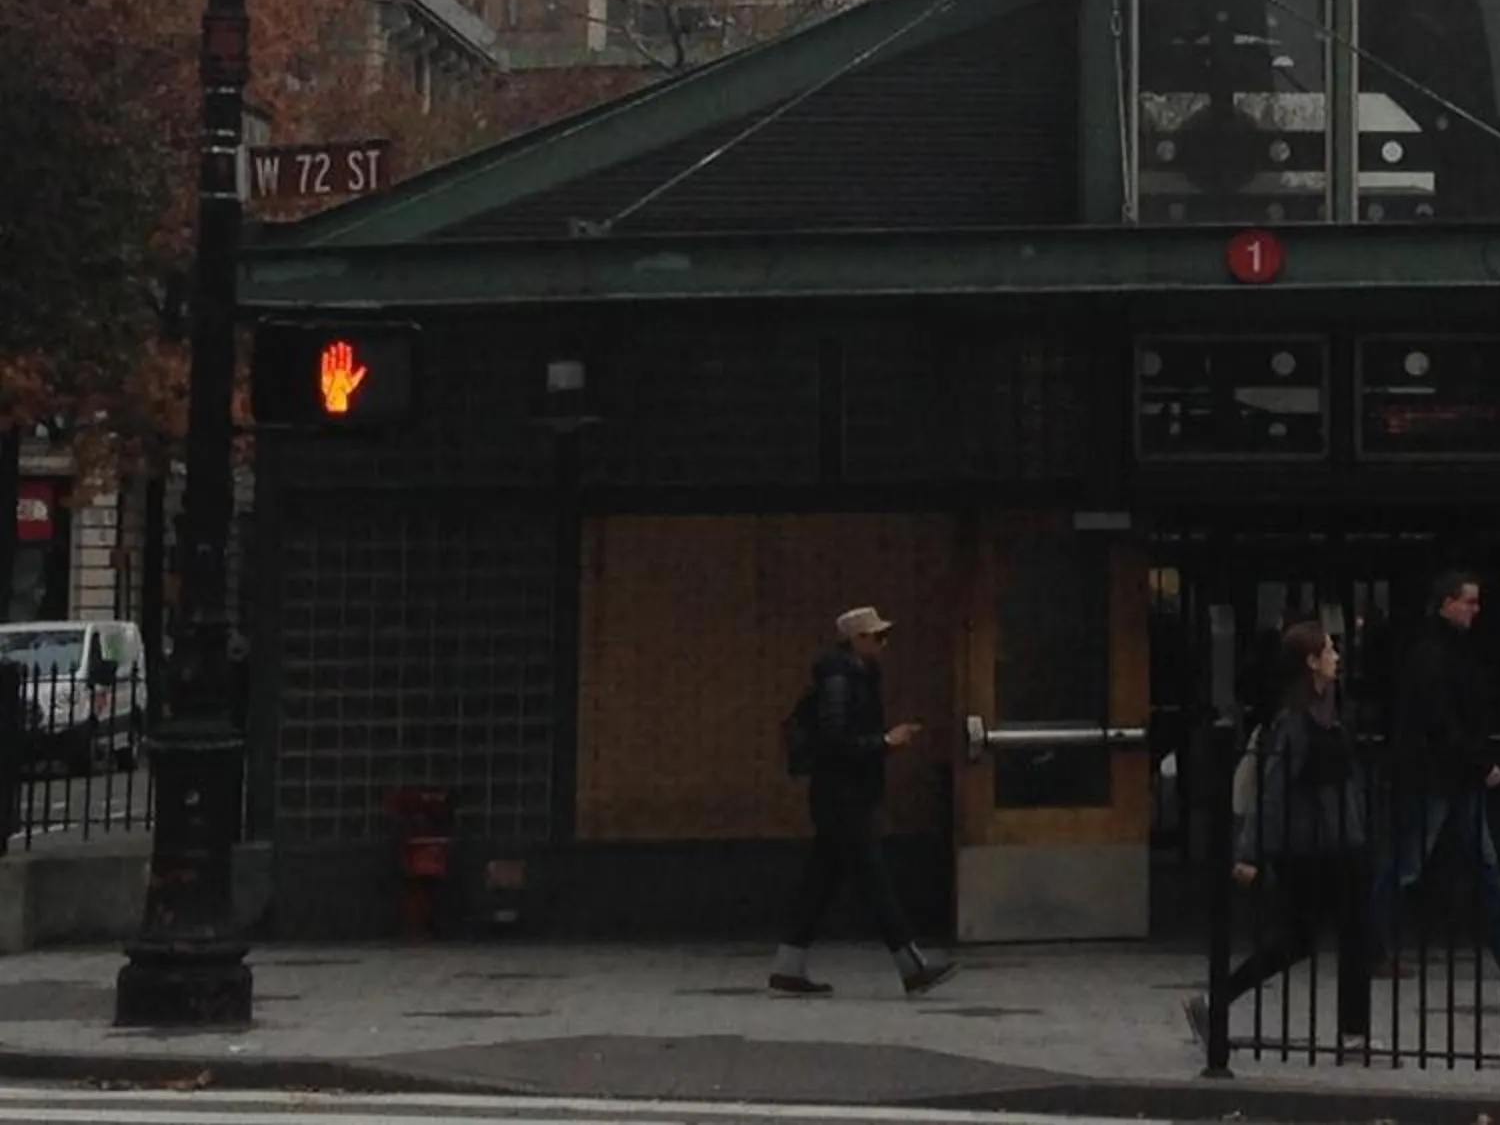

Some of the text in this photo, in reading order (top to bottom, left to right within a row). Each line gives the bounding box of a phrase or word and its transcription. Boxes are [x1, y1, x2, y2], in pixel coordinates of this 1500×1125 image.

[255, 149, 381, 197] W 72 ST
[1246, 240, 1261, 273] 1
